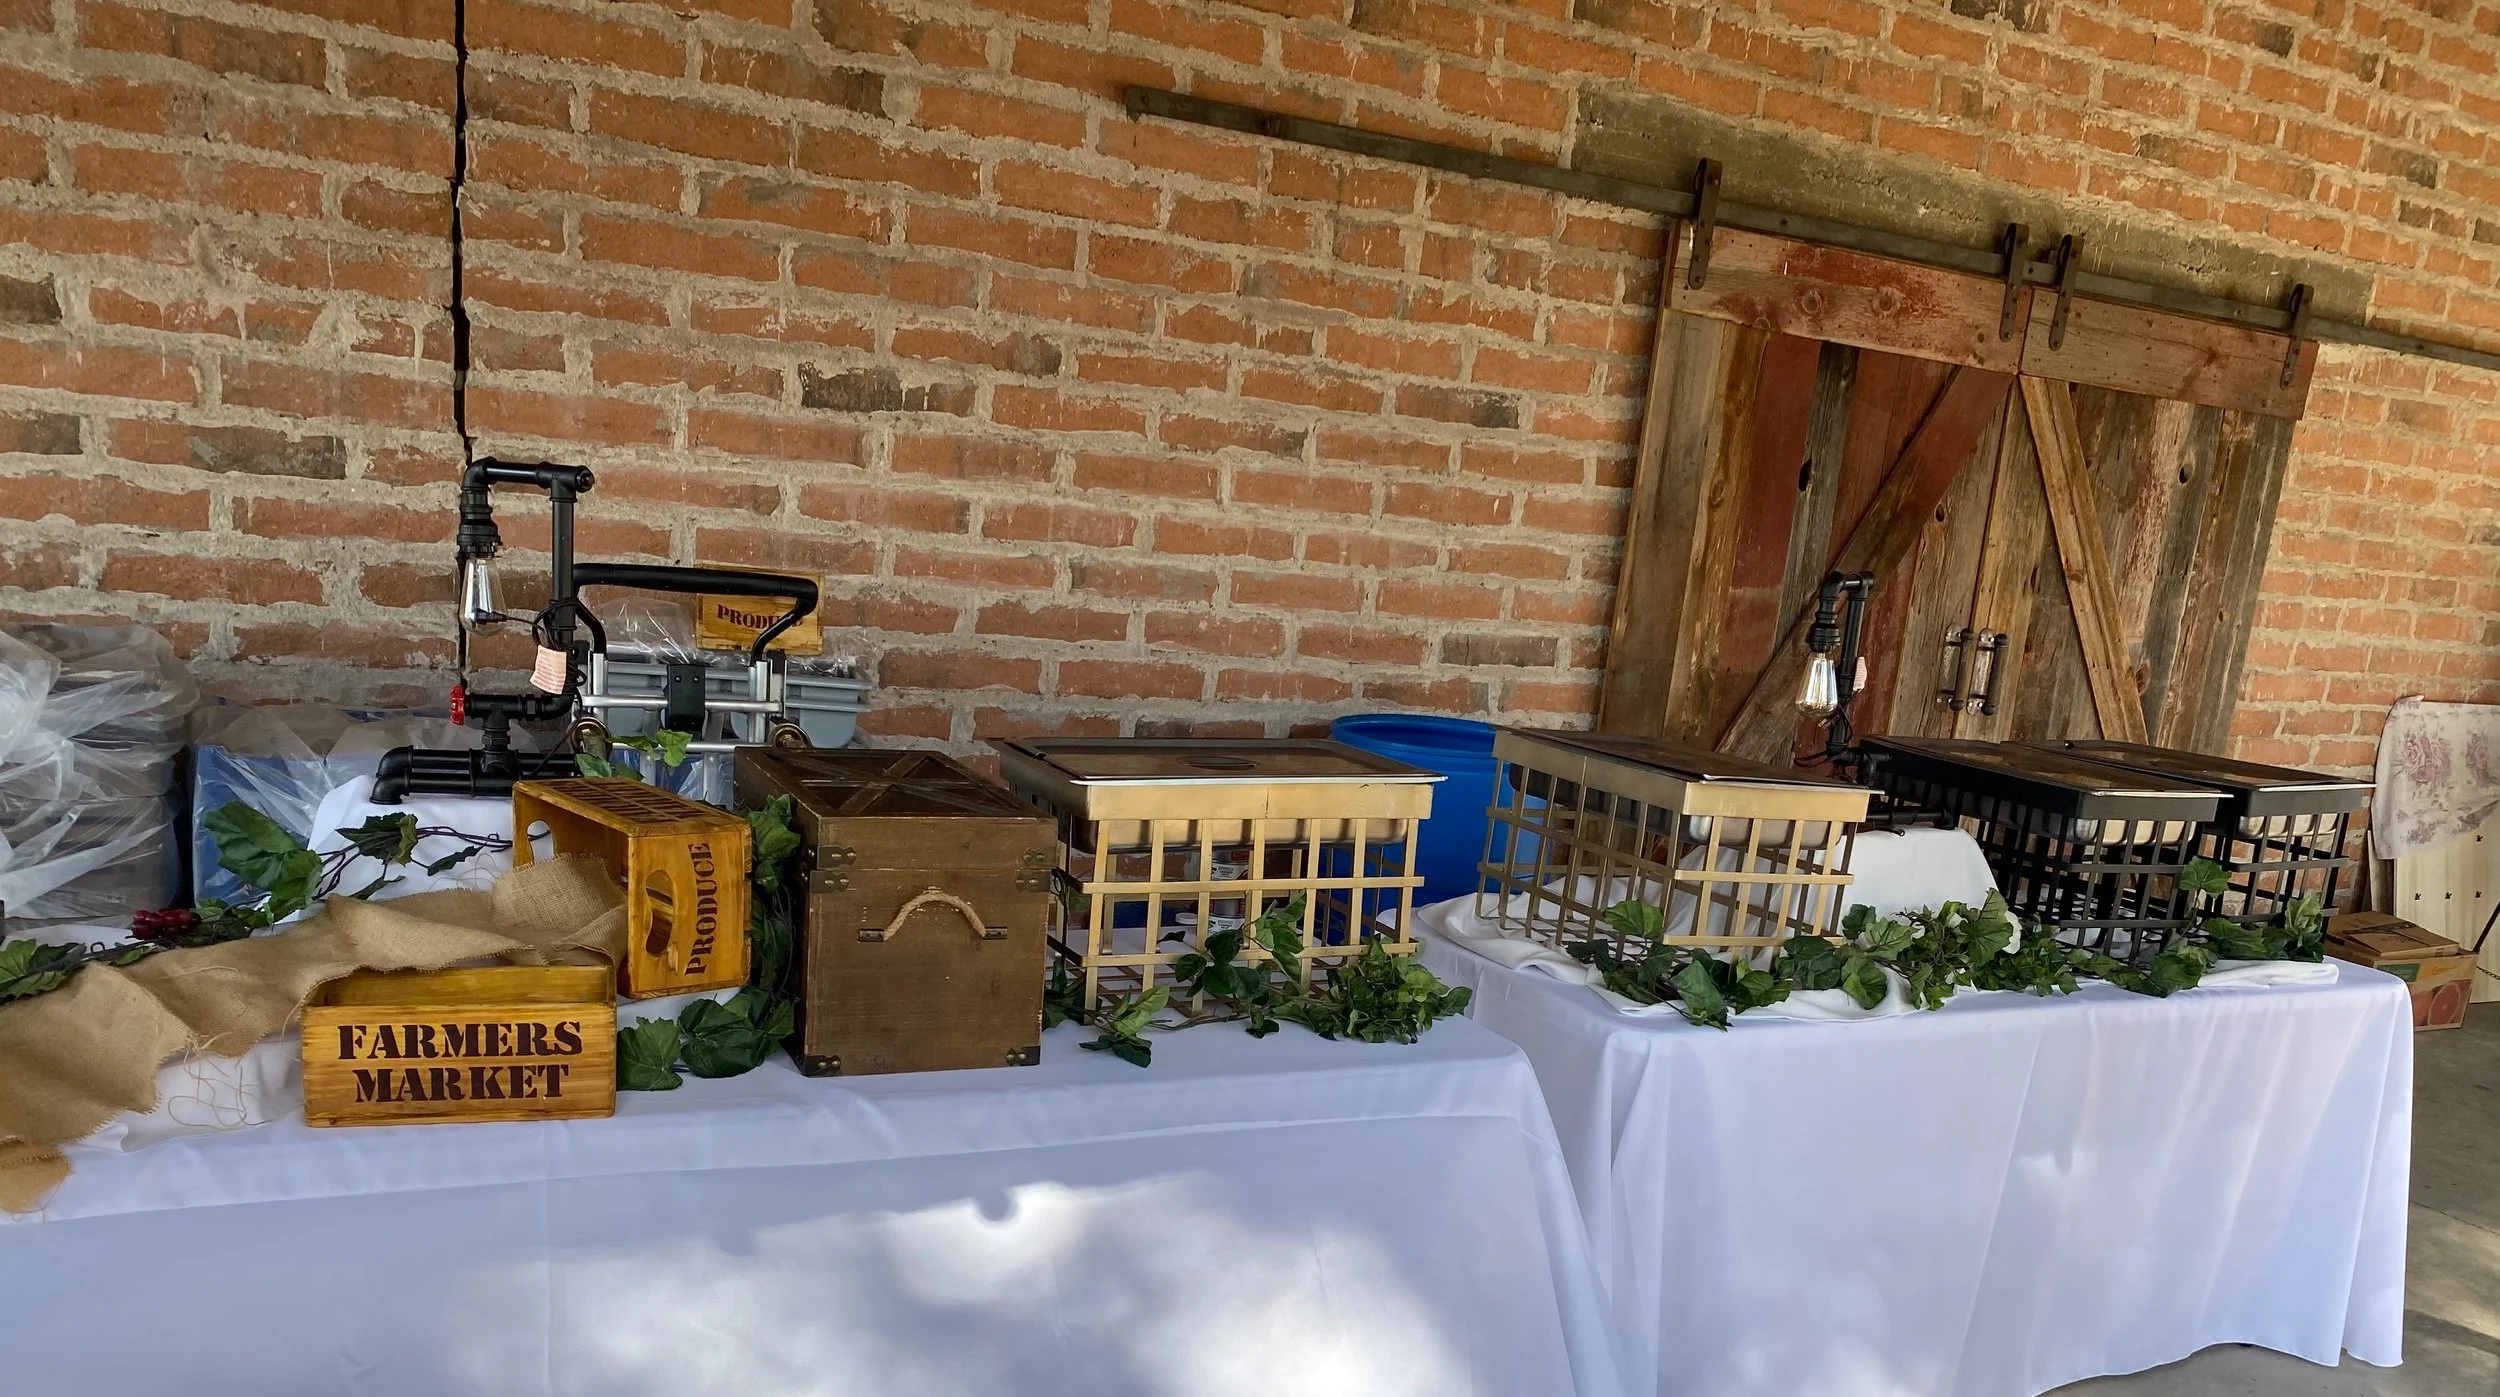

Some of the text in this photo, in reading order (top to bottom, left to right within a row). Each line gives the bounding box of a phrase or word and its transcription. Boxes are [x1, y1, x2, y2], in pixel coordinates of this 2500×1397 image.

[684, 843, 718, 976] PRODUCE
[337, 1021, 583, 1060] FARMERS
[352, 1064, 569, 1103] MARKET
